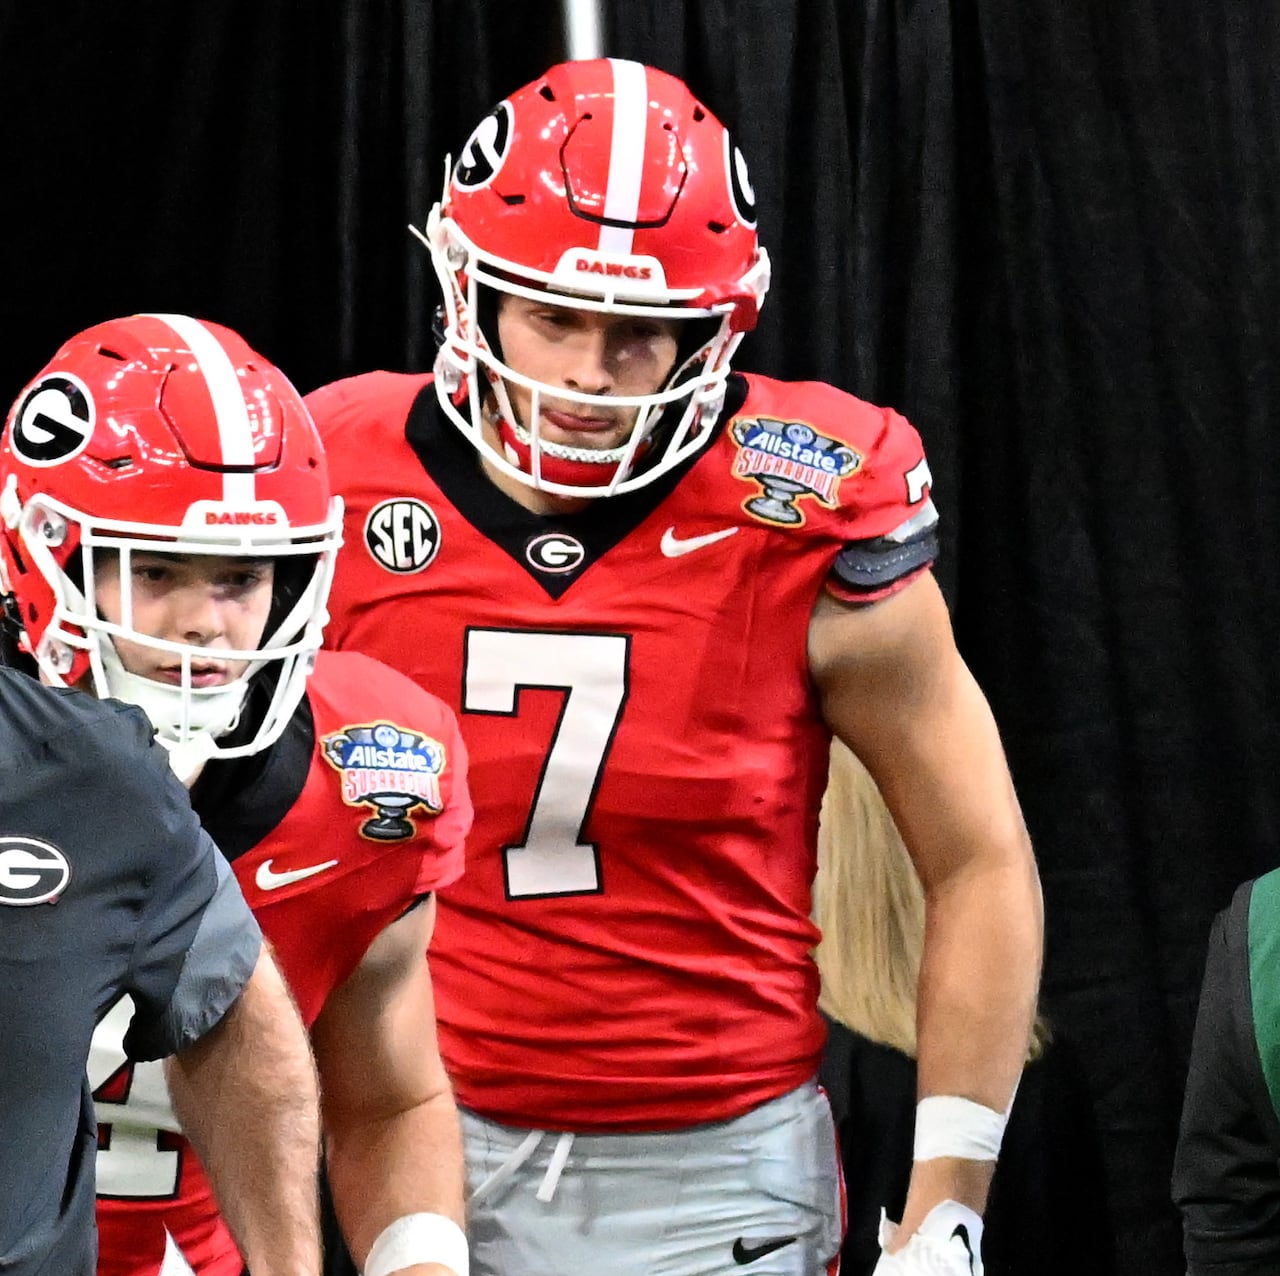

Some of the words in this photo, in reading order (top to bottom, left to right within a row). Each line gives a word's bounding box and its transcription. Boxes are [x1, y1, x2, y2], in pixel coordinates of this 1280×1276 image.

[575, 258, 653, 280] DAWGS
[10, 371, 96, 468] G
[748, 431, 837, 472] Allstate
[205, 511, 277, 526] DAWGS
[369, 502, 434, 569] SEC
[526, 533, 585, 573] G
[346, 745, 432, 773] Allstate
[460, 627, 631, 901] 7
